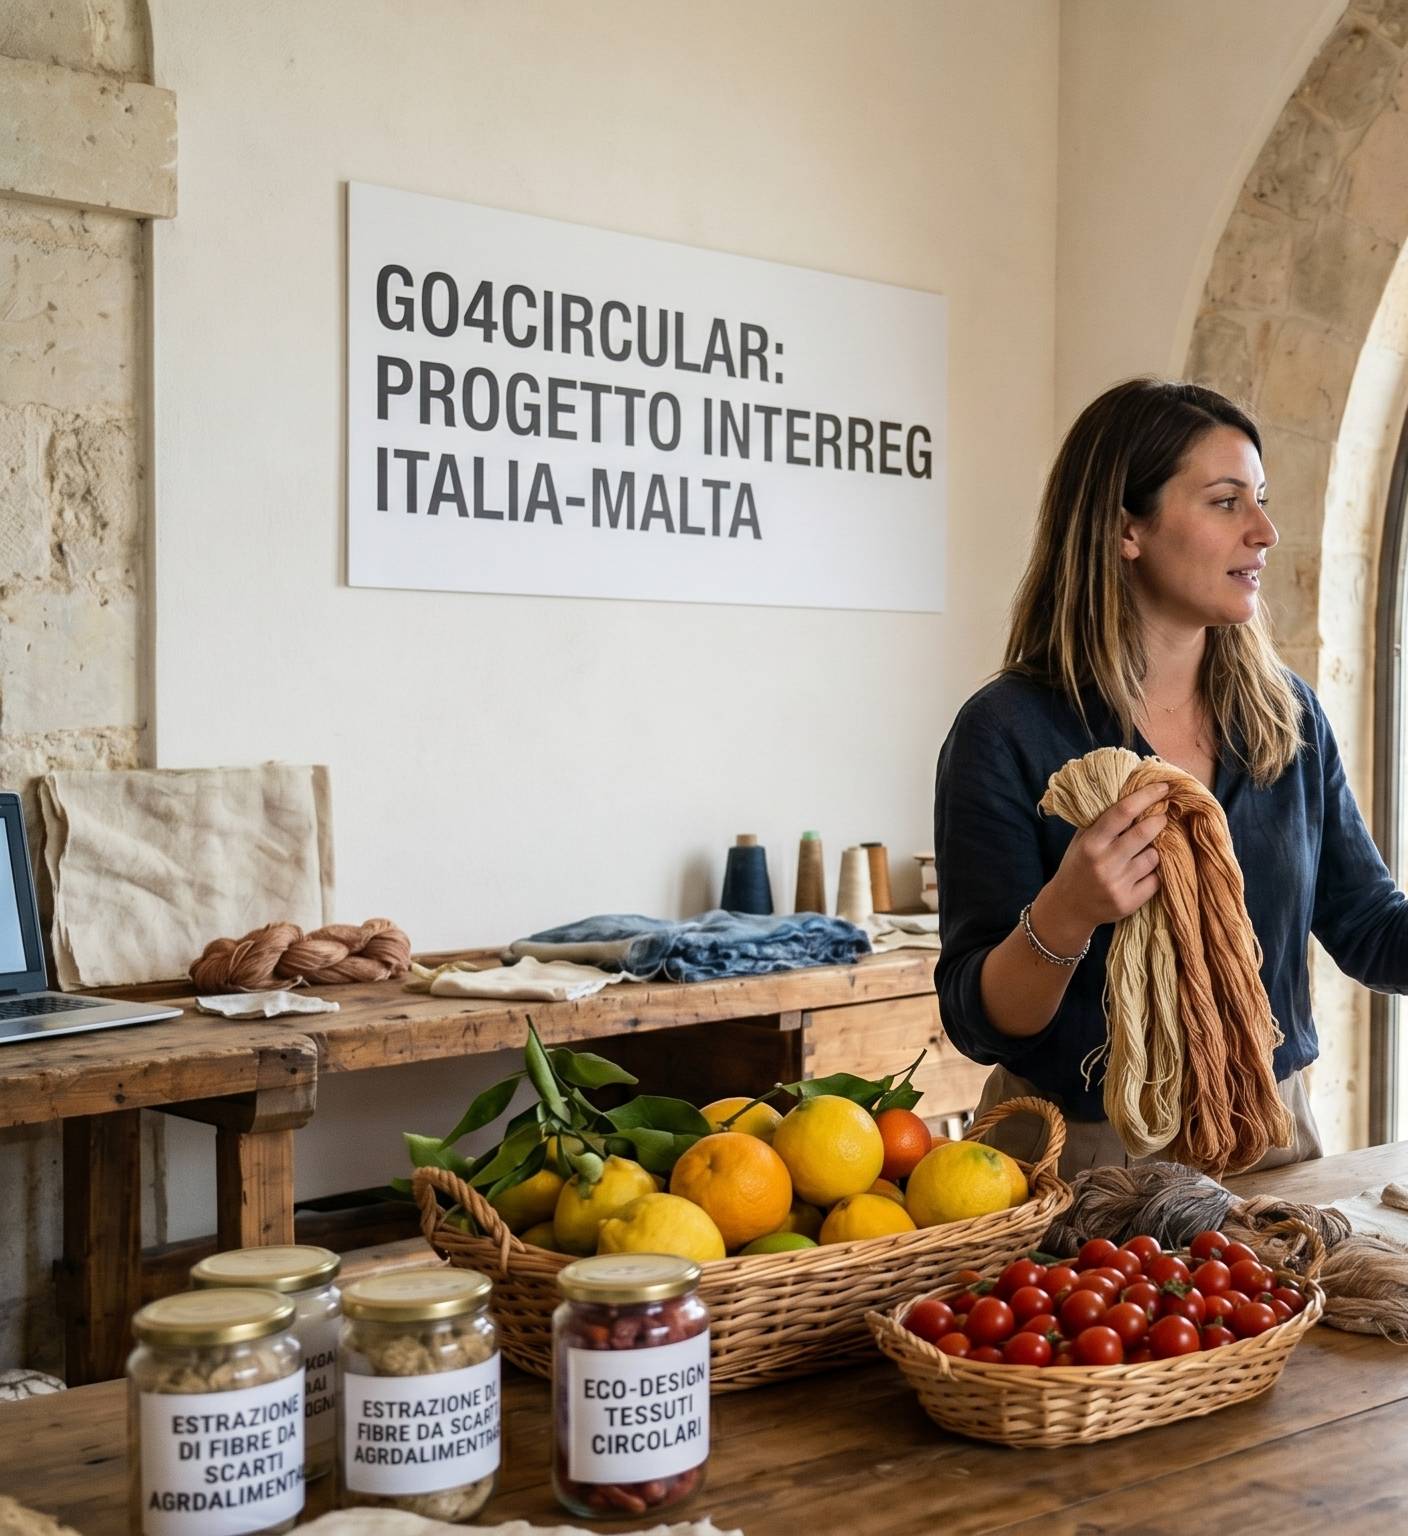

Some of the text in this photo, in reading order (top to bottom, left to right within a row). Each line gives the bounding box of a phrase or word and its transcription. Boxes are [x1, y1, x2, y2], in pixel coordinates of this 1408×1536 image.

[376, 264, 784, 384] GO4CIRCULAR:
[376, 355, 933, 480] PROGETTO INTERREG
[376, 446, 763, 540] ITALIA-MALTA
[584, 1363, 705, 1400] ECO-DESIGN
[172, 1394, 299, 1435] ESTRAZIONE
[362, 1389, 481, 1418] ESTRAZIONE
[604, 1394, 693, 1427] TESSUTI
[179, 1421, 296, 1460] DI FIBRE DA
[357, 1423, 410, 1442] FIBRE
[417, 1422, 444, 1441] DA
[592, 1416, 702, 1455] CIRCOLARI
[205, 1451, 283, 1484] SCARTI
